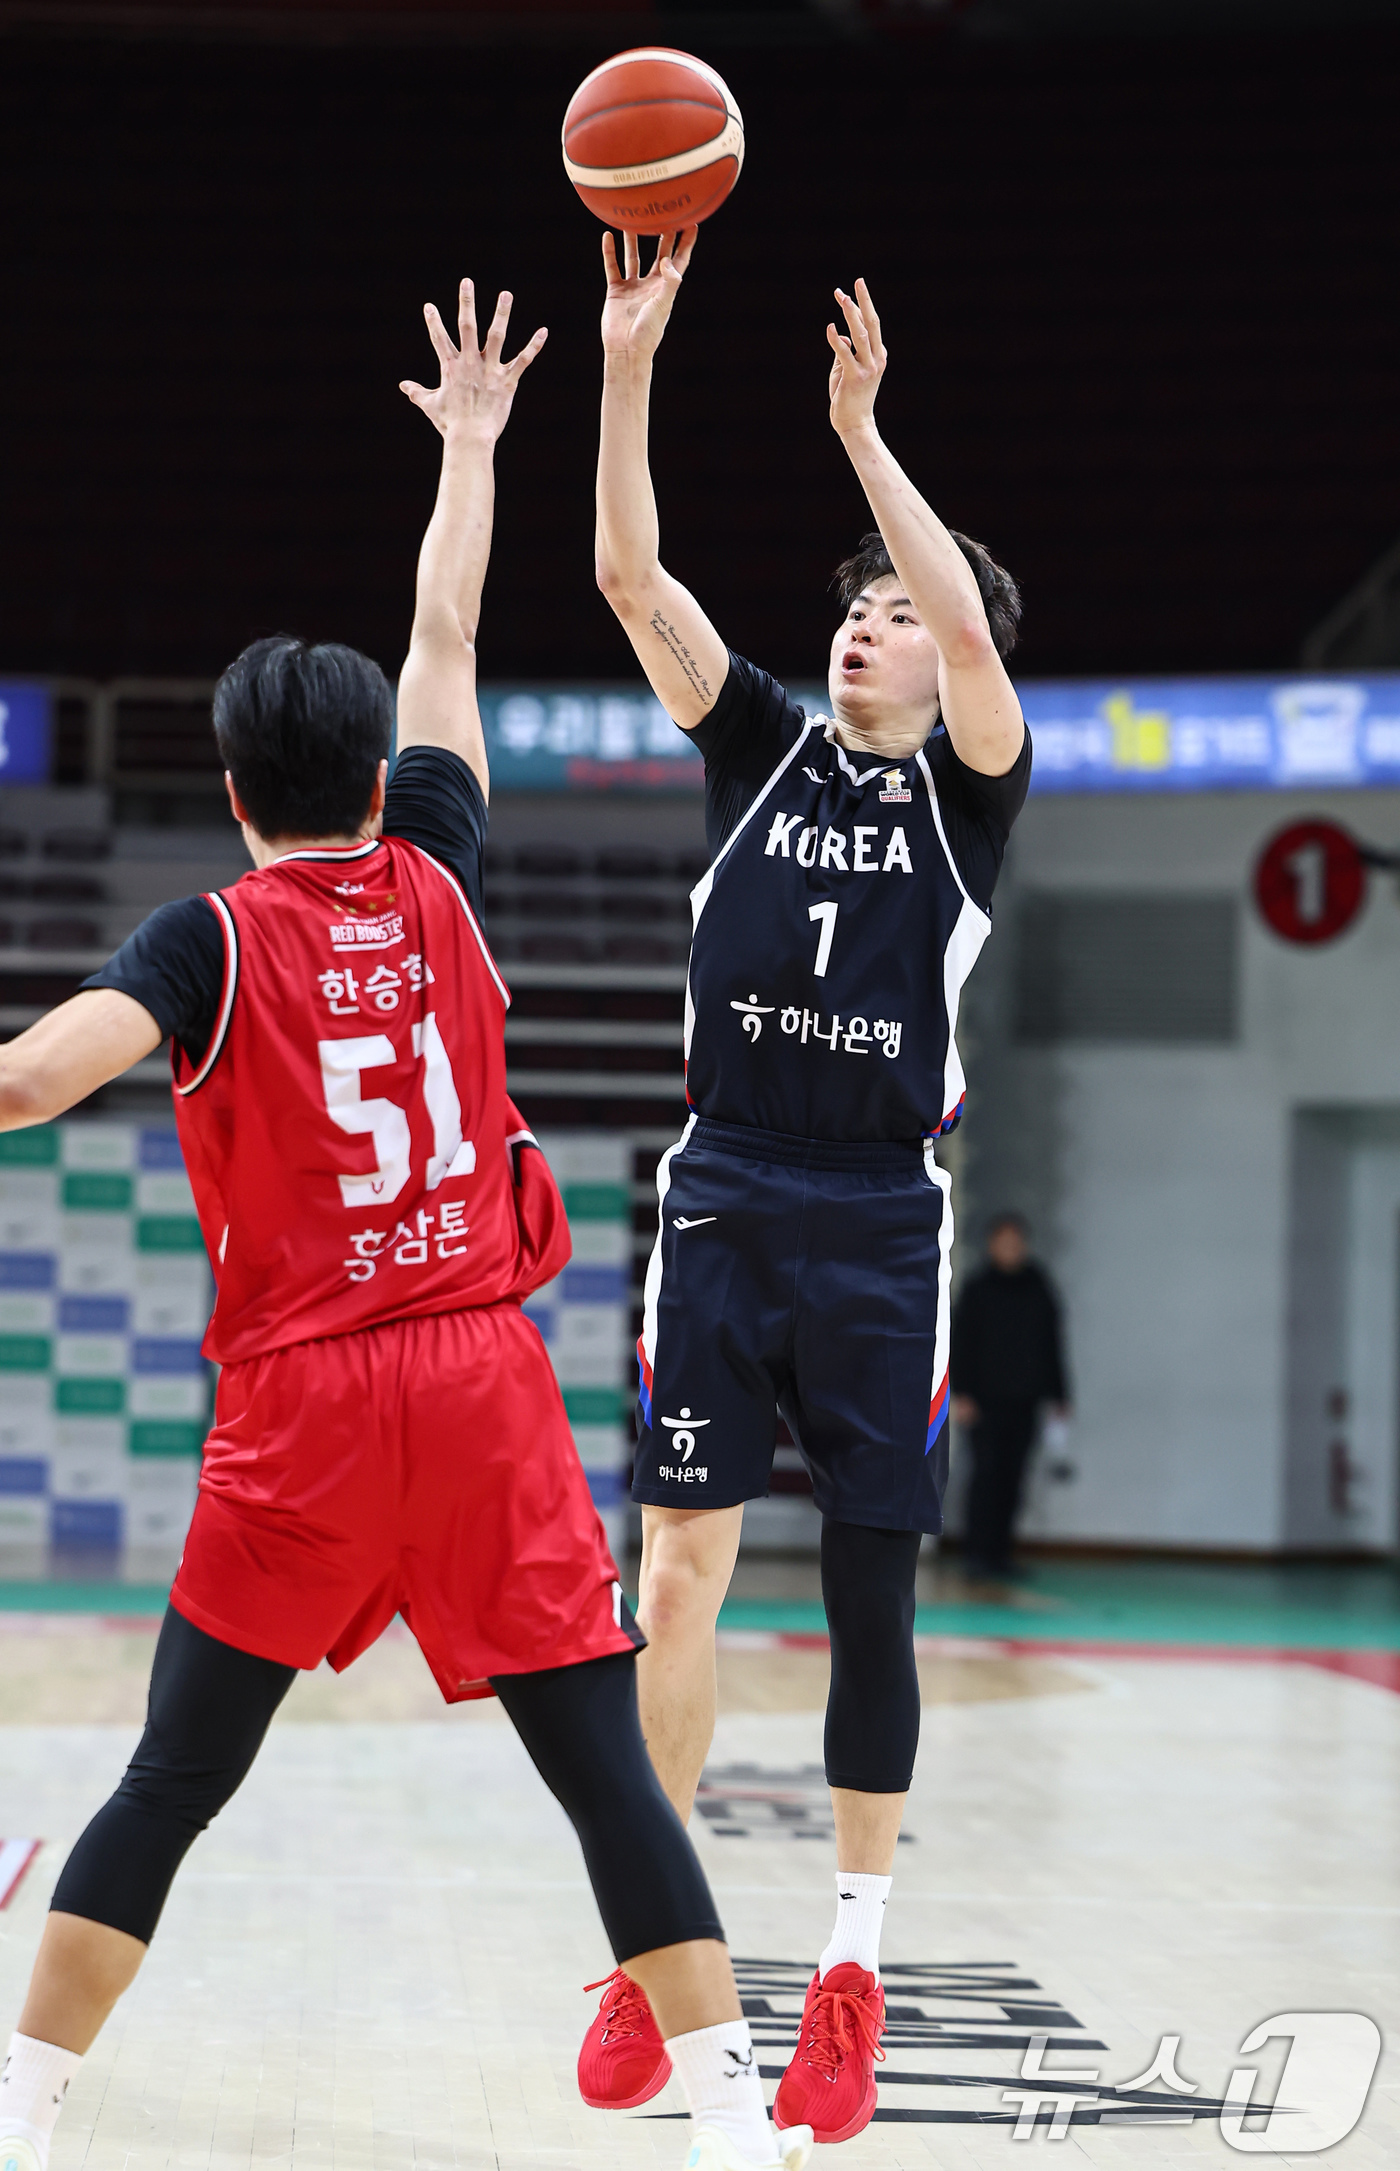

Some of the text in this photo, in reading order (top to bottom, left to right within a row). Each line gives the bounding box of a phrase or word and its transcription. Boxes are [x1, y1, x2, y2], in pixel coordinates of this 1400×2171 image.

[613, 164, 669, 184] QUALIFIERS
[613, 193, 692, 218] molten
[763, 811, 914, 874] KOREA
[1282, 840, 1325, 924] 1
[329, 925, 355, 943] RED
[808, 900, 839, 978] 1
[780, 1006, 903, 1060] 하나은행
[317, 1011, 476, 1208] 51
[343, 1200, 470, 1282] 홍삼톤
[658, 1465, 708, 1483] 하나은행
